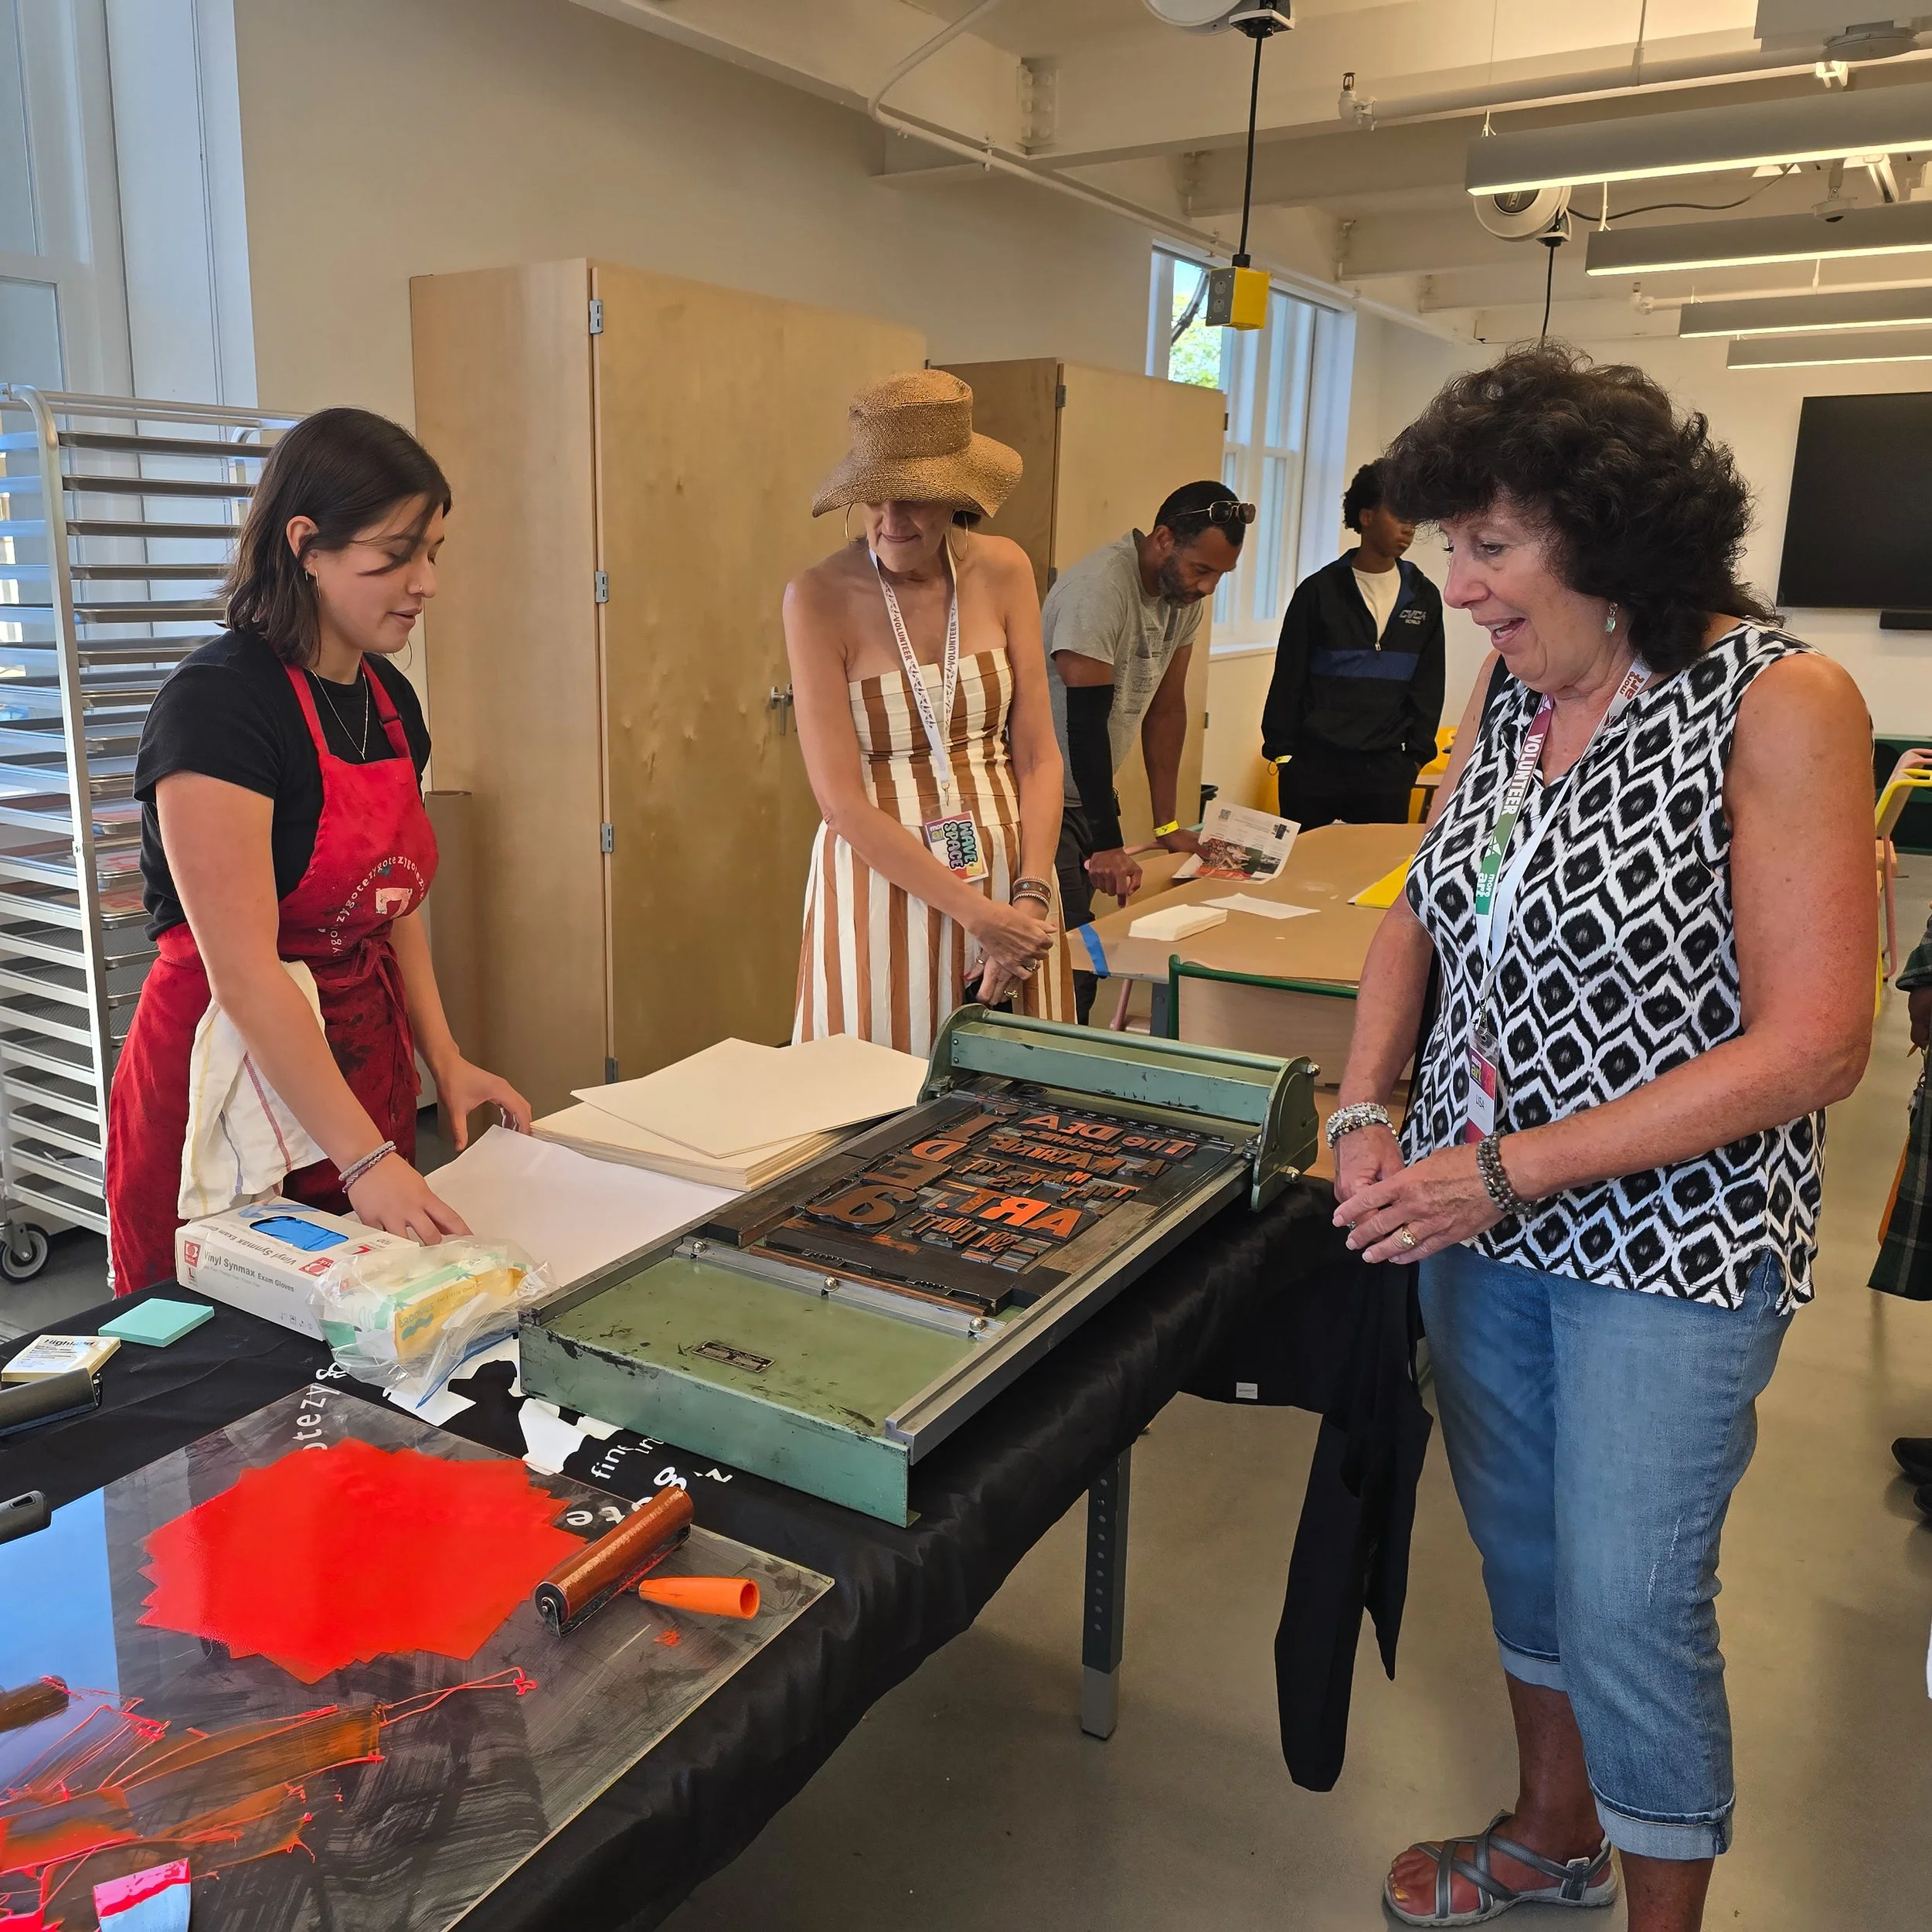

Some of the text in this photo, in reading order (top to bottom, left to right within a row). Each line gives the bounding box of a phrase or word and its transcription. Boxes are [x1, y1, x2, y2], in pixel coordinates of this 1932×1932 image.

[893, 617, 912, 662] VOLUNTEER
[947, 621, 957, 665] VOLUNTEER
[1619, 671, 1634, 694] more
[1624, 672, 1645, 700] art
[1501, 733, 1544, 815] VOLUNTEER
[944, 821, 964, 869] SPACE
[958, 821, 978, 864] WAVE
[1477, 872, 1488, 897] art
[219, 1230, 237, 1241] Exam
[236, 1238, 273, 1256] Synmax
[204, 1250, 223, 1266] Vinyl
[223, 1258, 256, 1277] Synmax
[257, 1273, 274, 1284] Exam
[274, 1279, 294, 1292] Gloves
[270, 1252, 298, 1266] Vinyl
